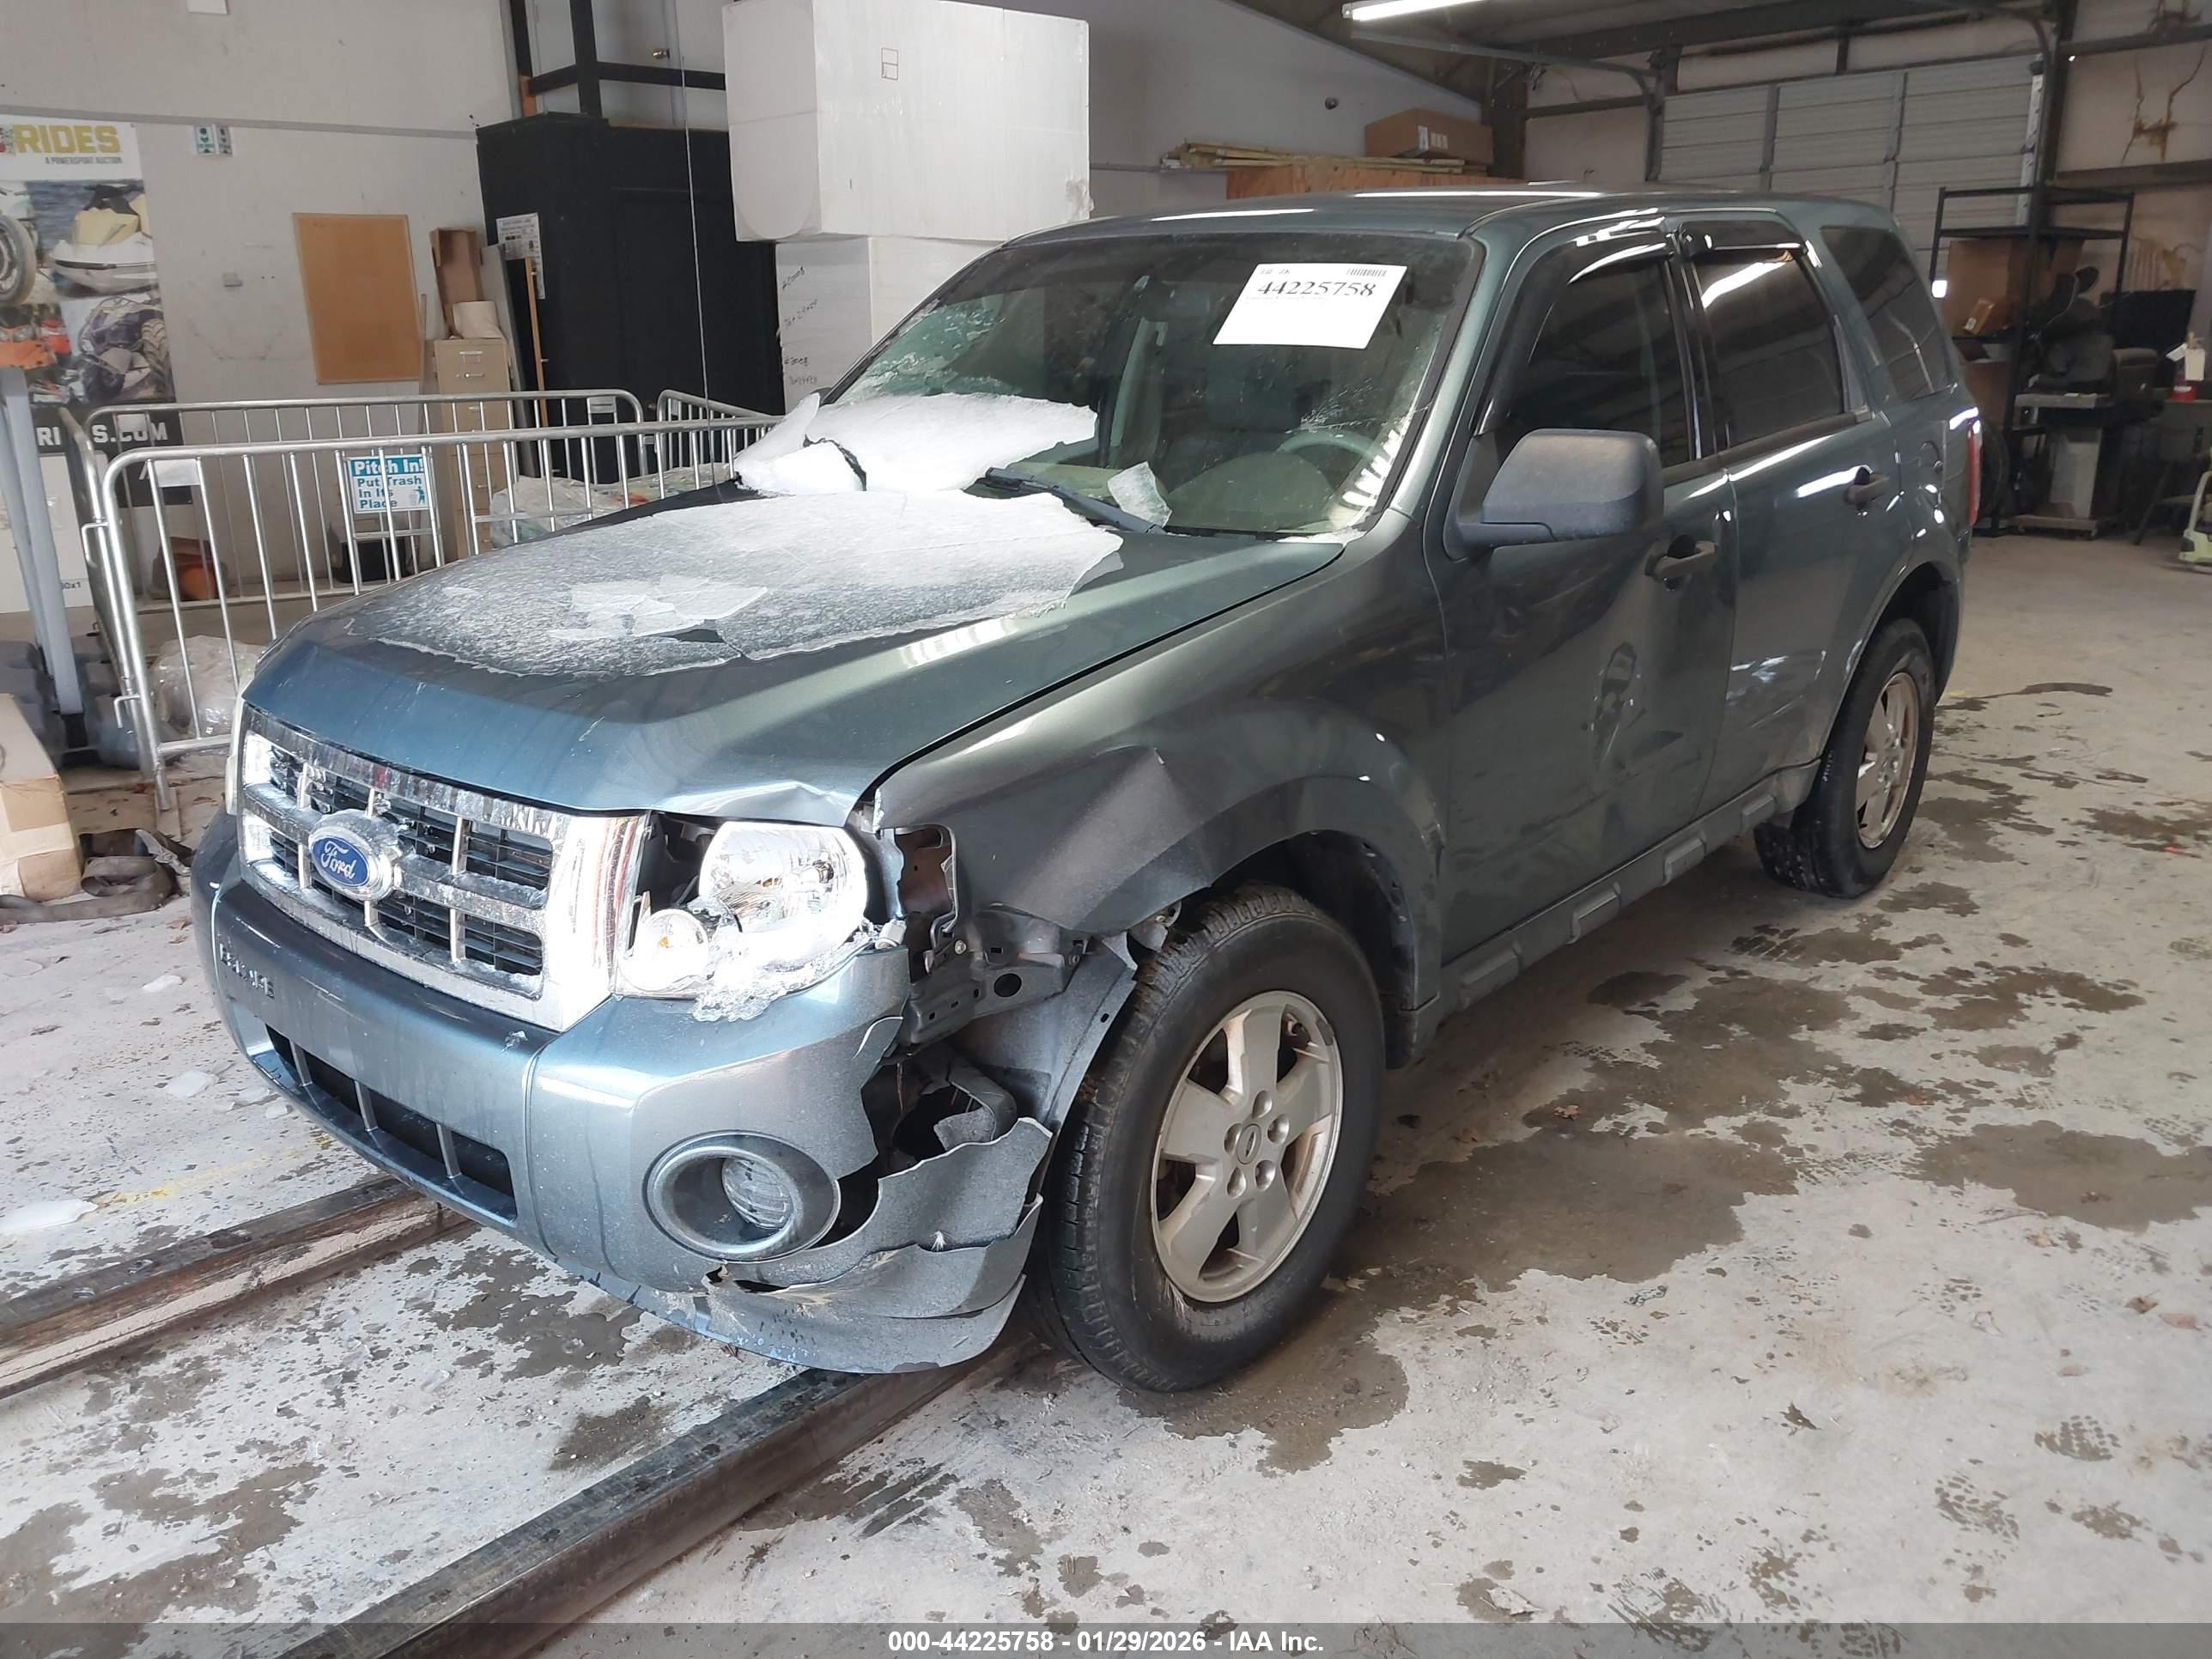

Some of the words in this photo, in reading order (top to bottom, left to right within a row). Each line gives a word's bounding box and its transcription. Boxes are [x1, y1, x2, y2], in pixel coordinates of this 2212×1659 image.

[13, 124, 121, 154] RIDES
[1257, 281, 1377, 297] 44225758
[403, 457, 424, 472] In!
[357, 477, 380, 488] Put
[387, 475, 422, 486] Trash
[358, 489, 371, 498] In
[320, 840, 357, 880] Ford
